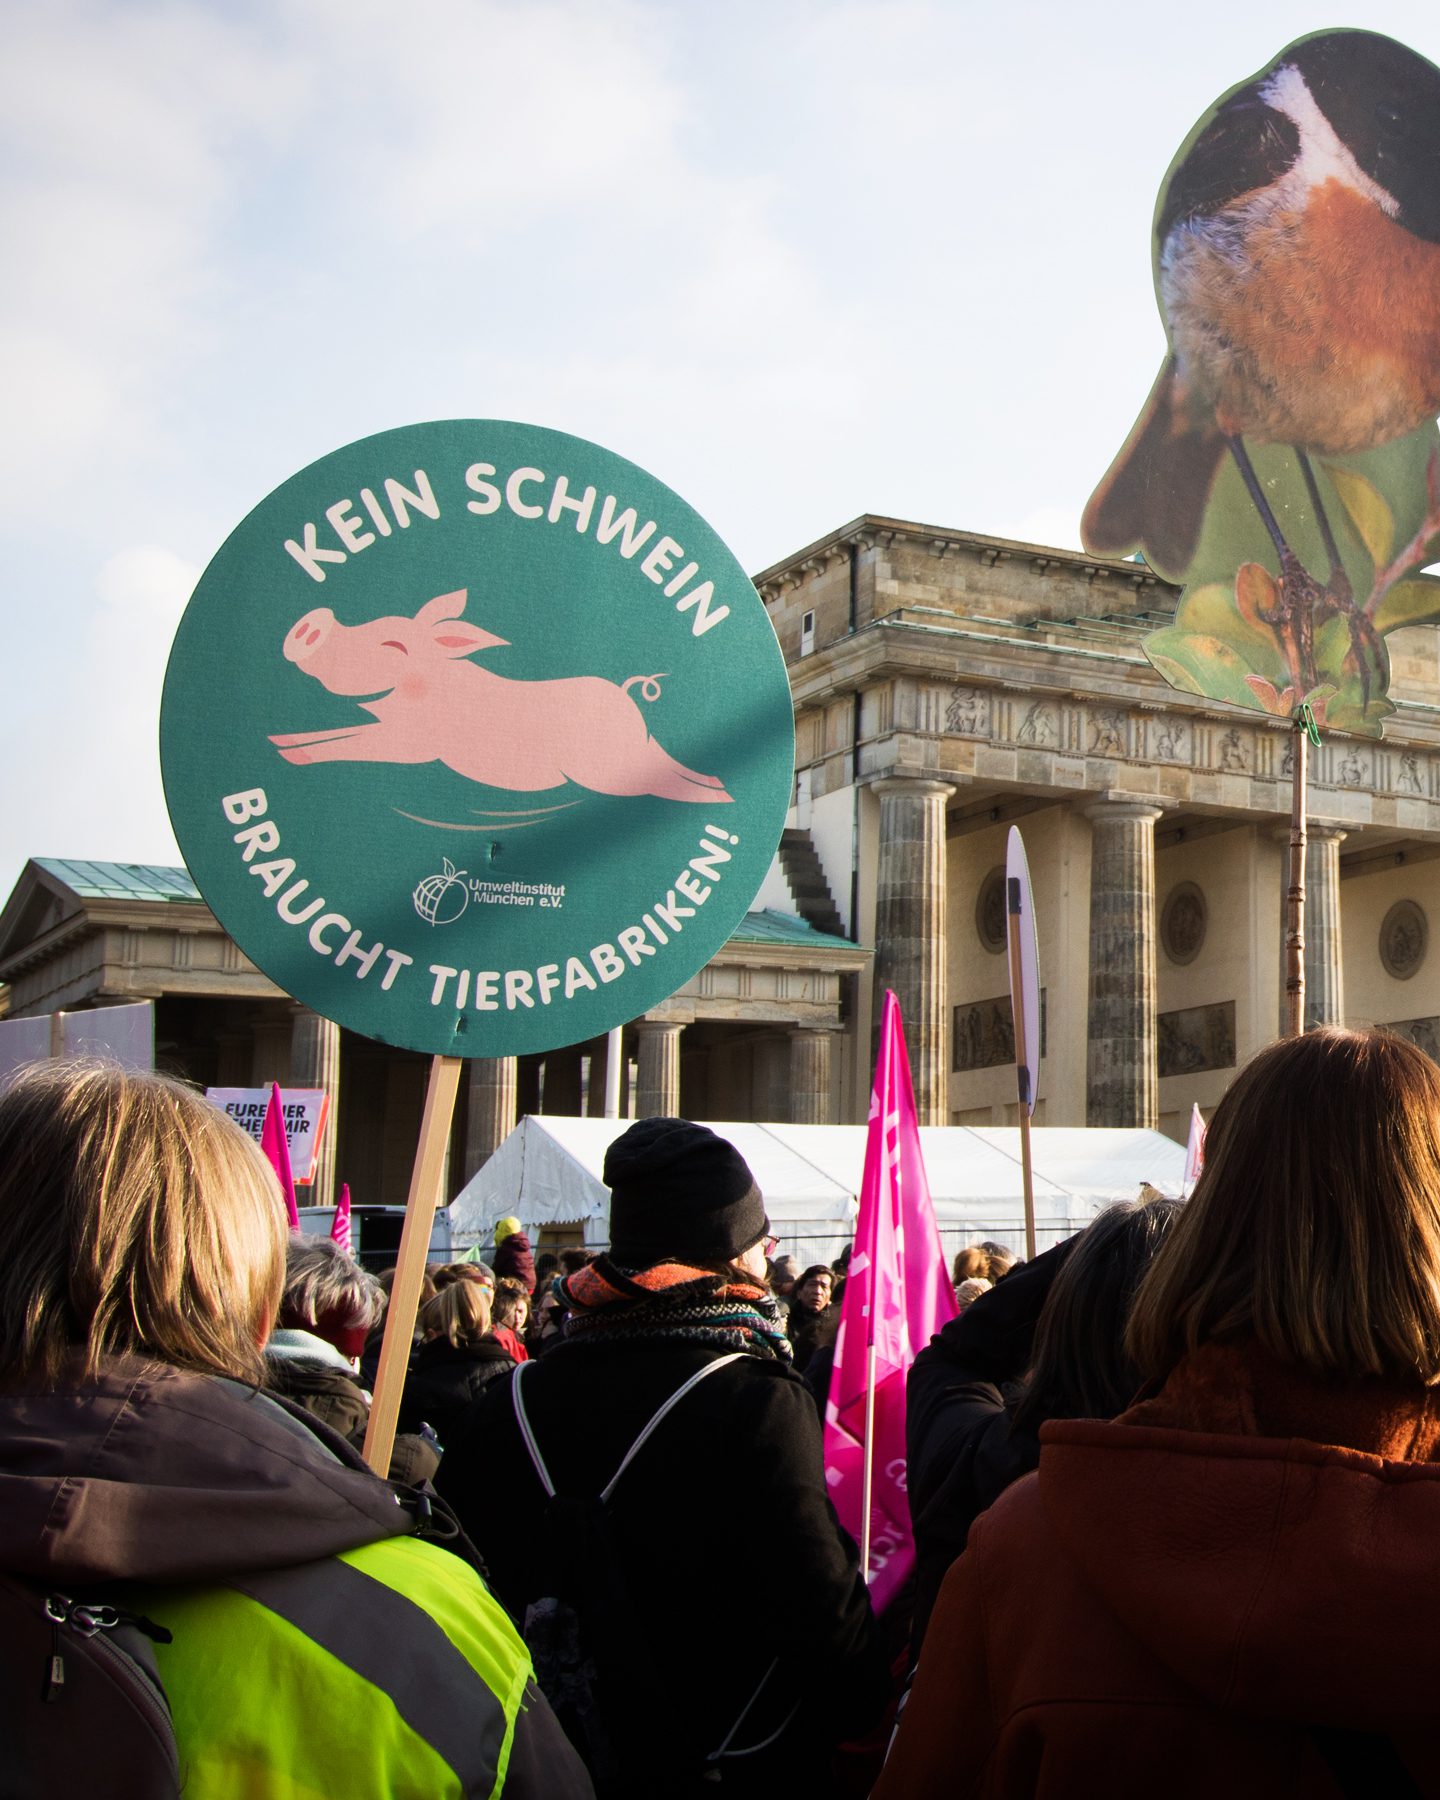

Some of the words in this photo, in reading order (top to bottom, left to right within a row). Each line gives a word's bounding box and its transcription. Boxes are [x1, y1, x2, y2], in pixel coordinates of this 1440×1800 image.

[283, 469, 441, 583] KEIN
[465, 462, 731, 637] SCHWEIN
[221, 787, 413, 991] BRAUCHT
[429, 824, 740, 1011] TIERFABRIKEN!
[468, 879, 566, 897] Umweltinstitut
[474, 891, 534, 906] München
[540, 897, 562, 908] e.V.
